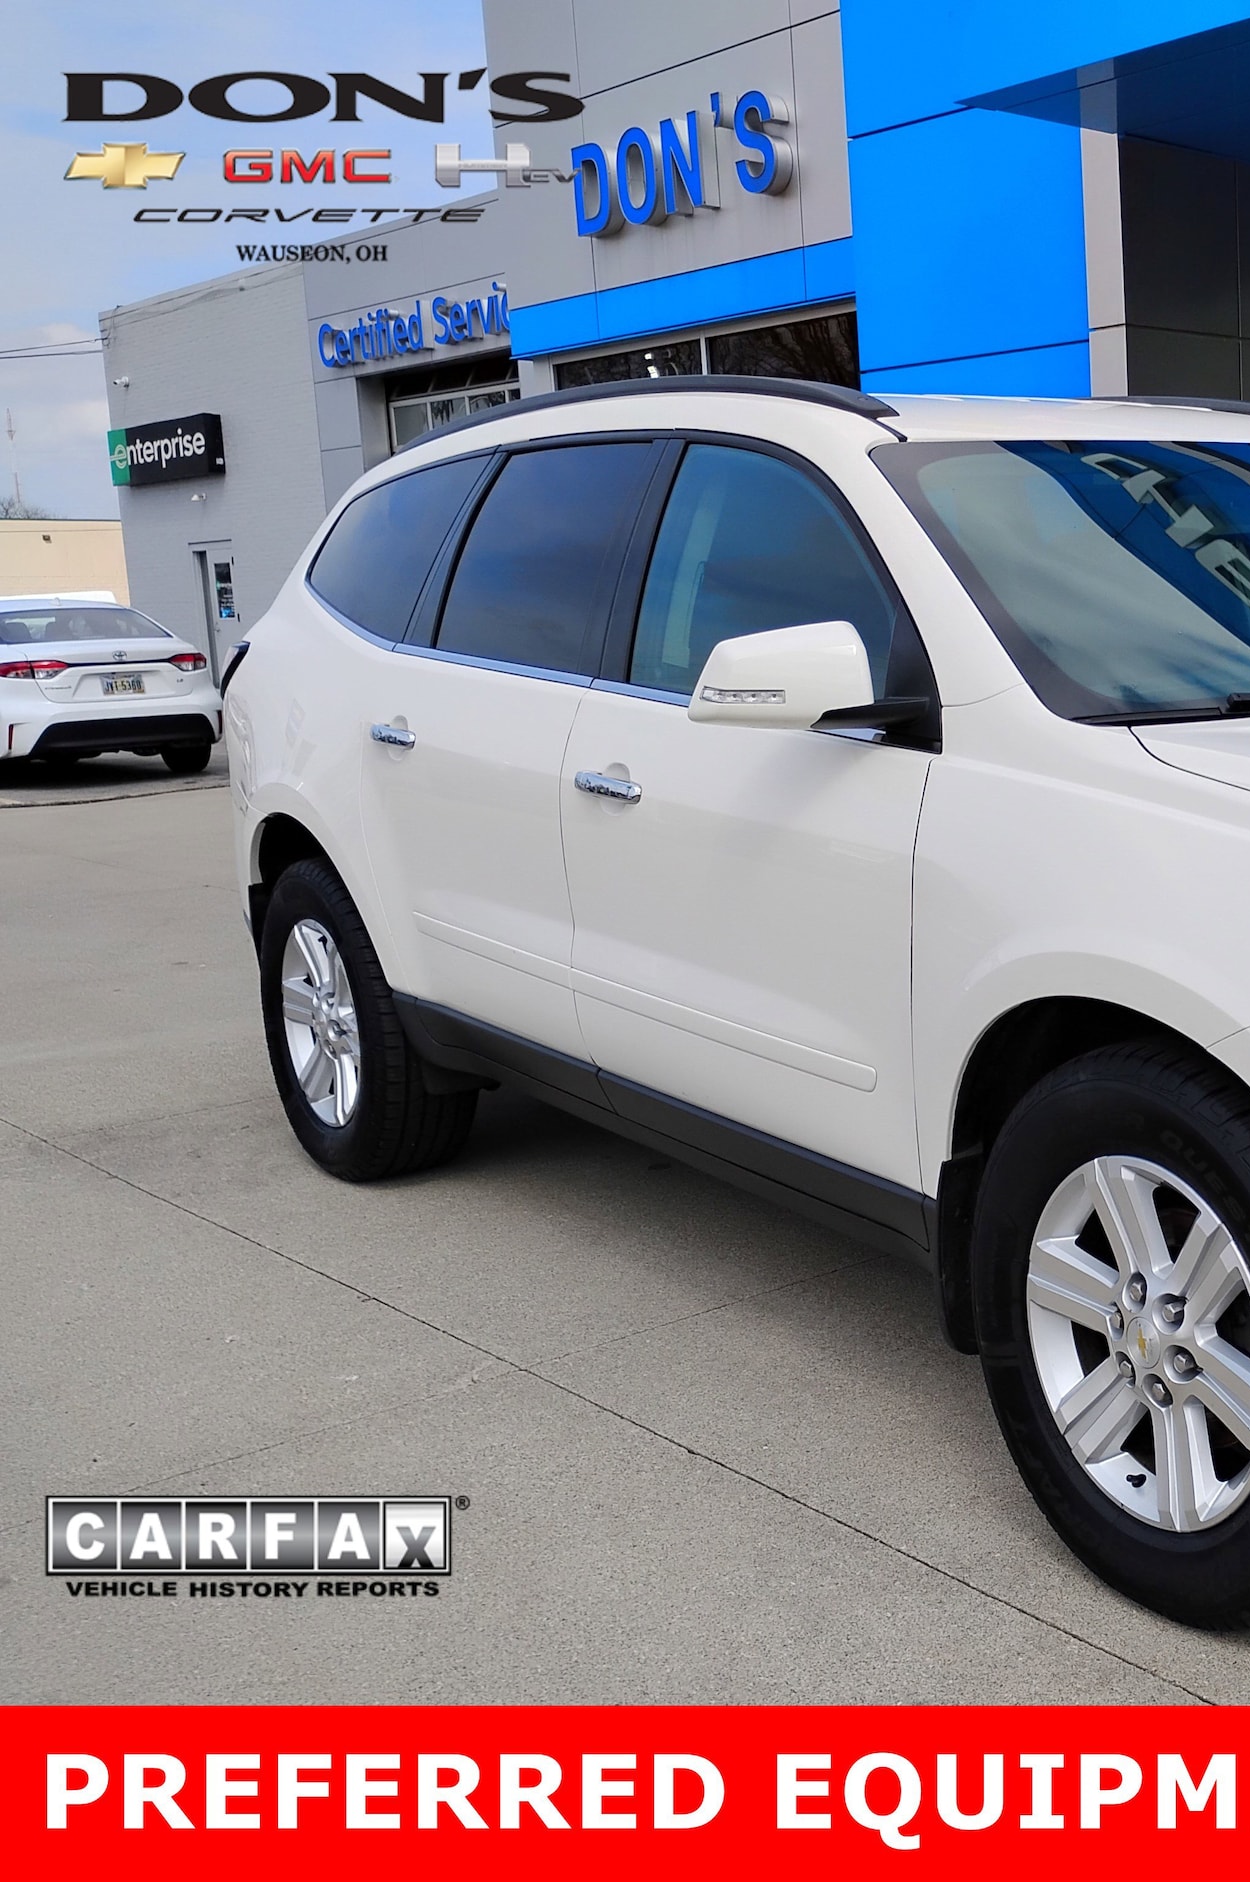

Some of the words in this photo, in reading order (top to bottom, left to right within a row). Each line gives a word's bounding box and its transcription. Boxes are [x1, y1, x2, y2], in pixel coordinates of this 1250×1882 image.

[571, 89, 780, 237] DON'S
[318, 300, 425, 368] Certified
[109, 428, 206, 469] enterprise
